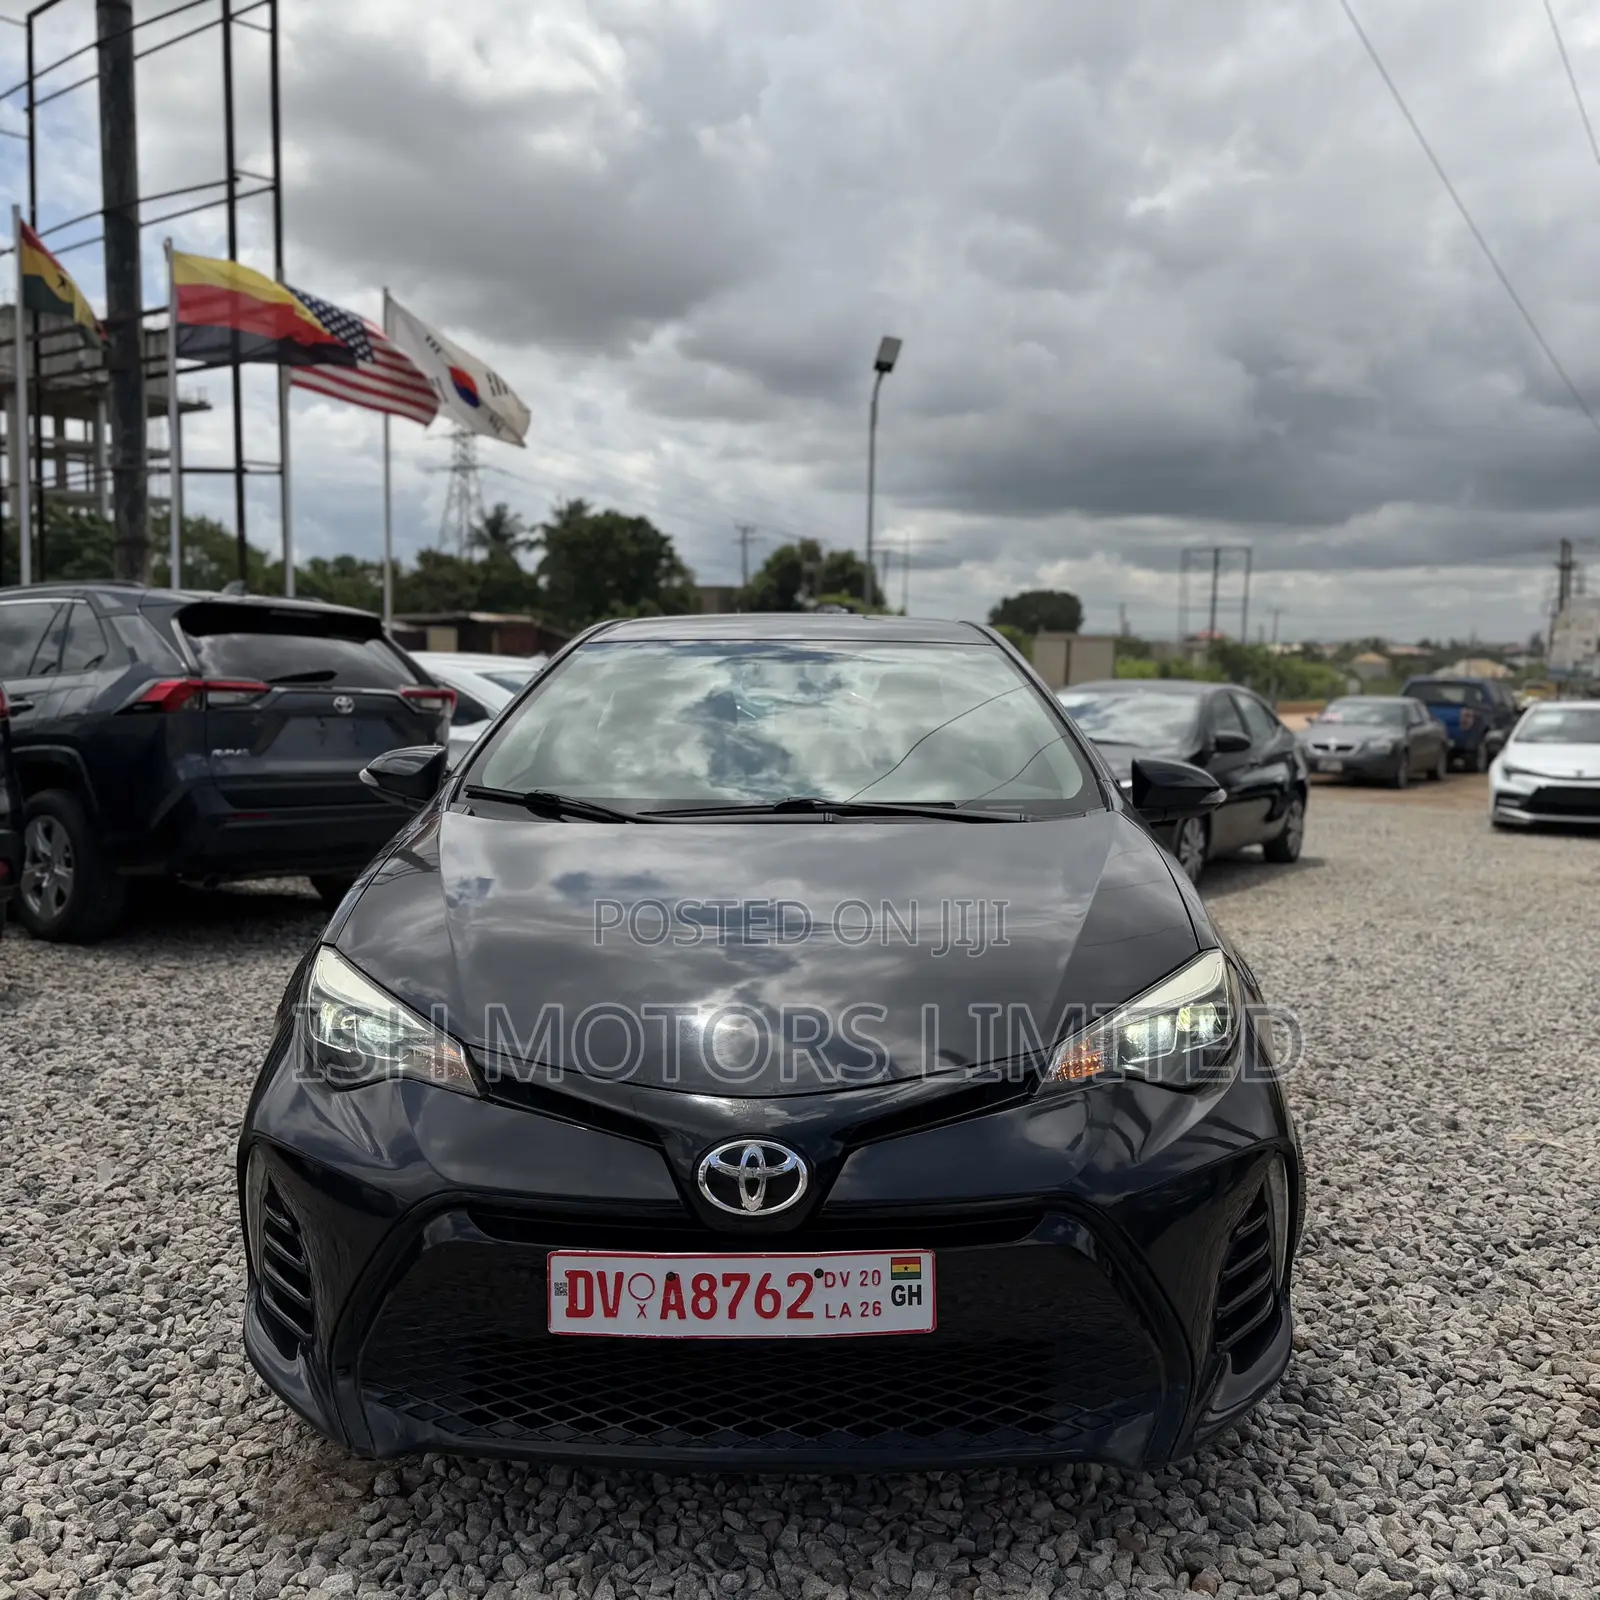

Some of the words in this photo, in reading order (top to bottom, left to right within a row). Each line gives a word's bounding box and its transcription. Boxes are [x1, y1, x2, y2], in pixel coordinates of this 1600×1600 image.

[824, 1271, 850, 1288] DV
[859, 1269, 881, 1287] 20
[565, 1270, 624, 1317] DV
[660, 1272, 814, 1319] A8762
[891, 1284, 922, 1307] GH
[825, 1302, 852, 1319] LA
[860, 1301, 882, 1318] 26
